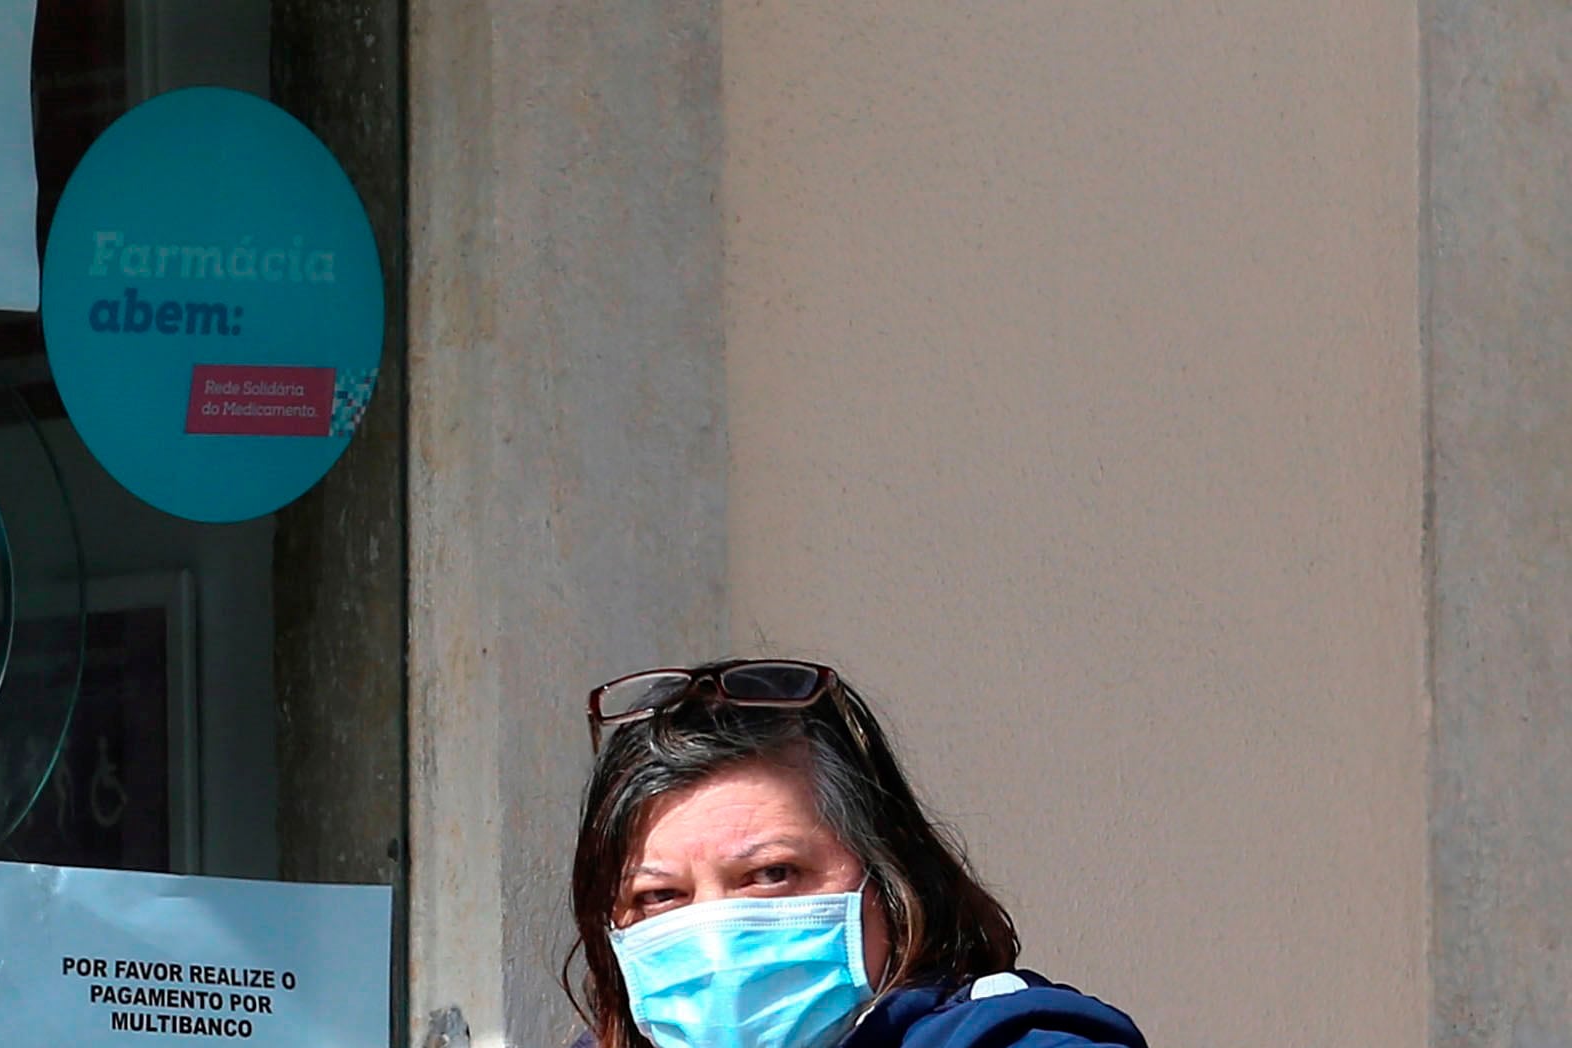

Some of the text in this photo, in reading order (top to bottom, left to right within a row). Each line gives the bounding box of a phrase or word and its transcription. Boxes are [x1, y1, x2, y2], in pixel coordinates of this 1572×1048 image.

[88, 231, 335, 282] Farmácia
[89, 287, 243, 336] abem:
[204, 380, 305, 396] Rede Solidária
[202, 401, 219, 415] do
[63, 958, 295, 989] POR FAVOR REALIZE O
[91, 985, 272, 1013] PAGAMENTO POR
[111, 1012, 253, 1038] MULTIBANCO
